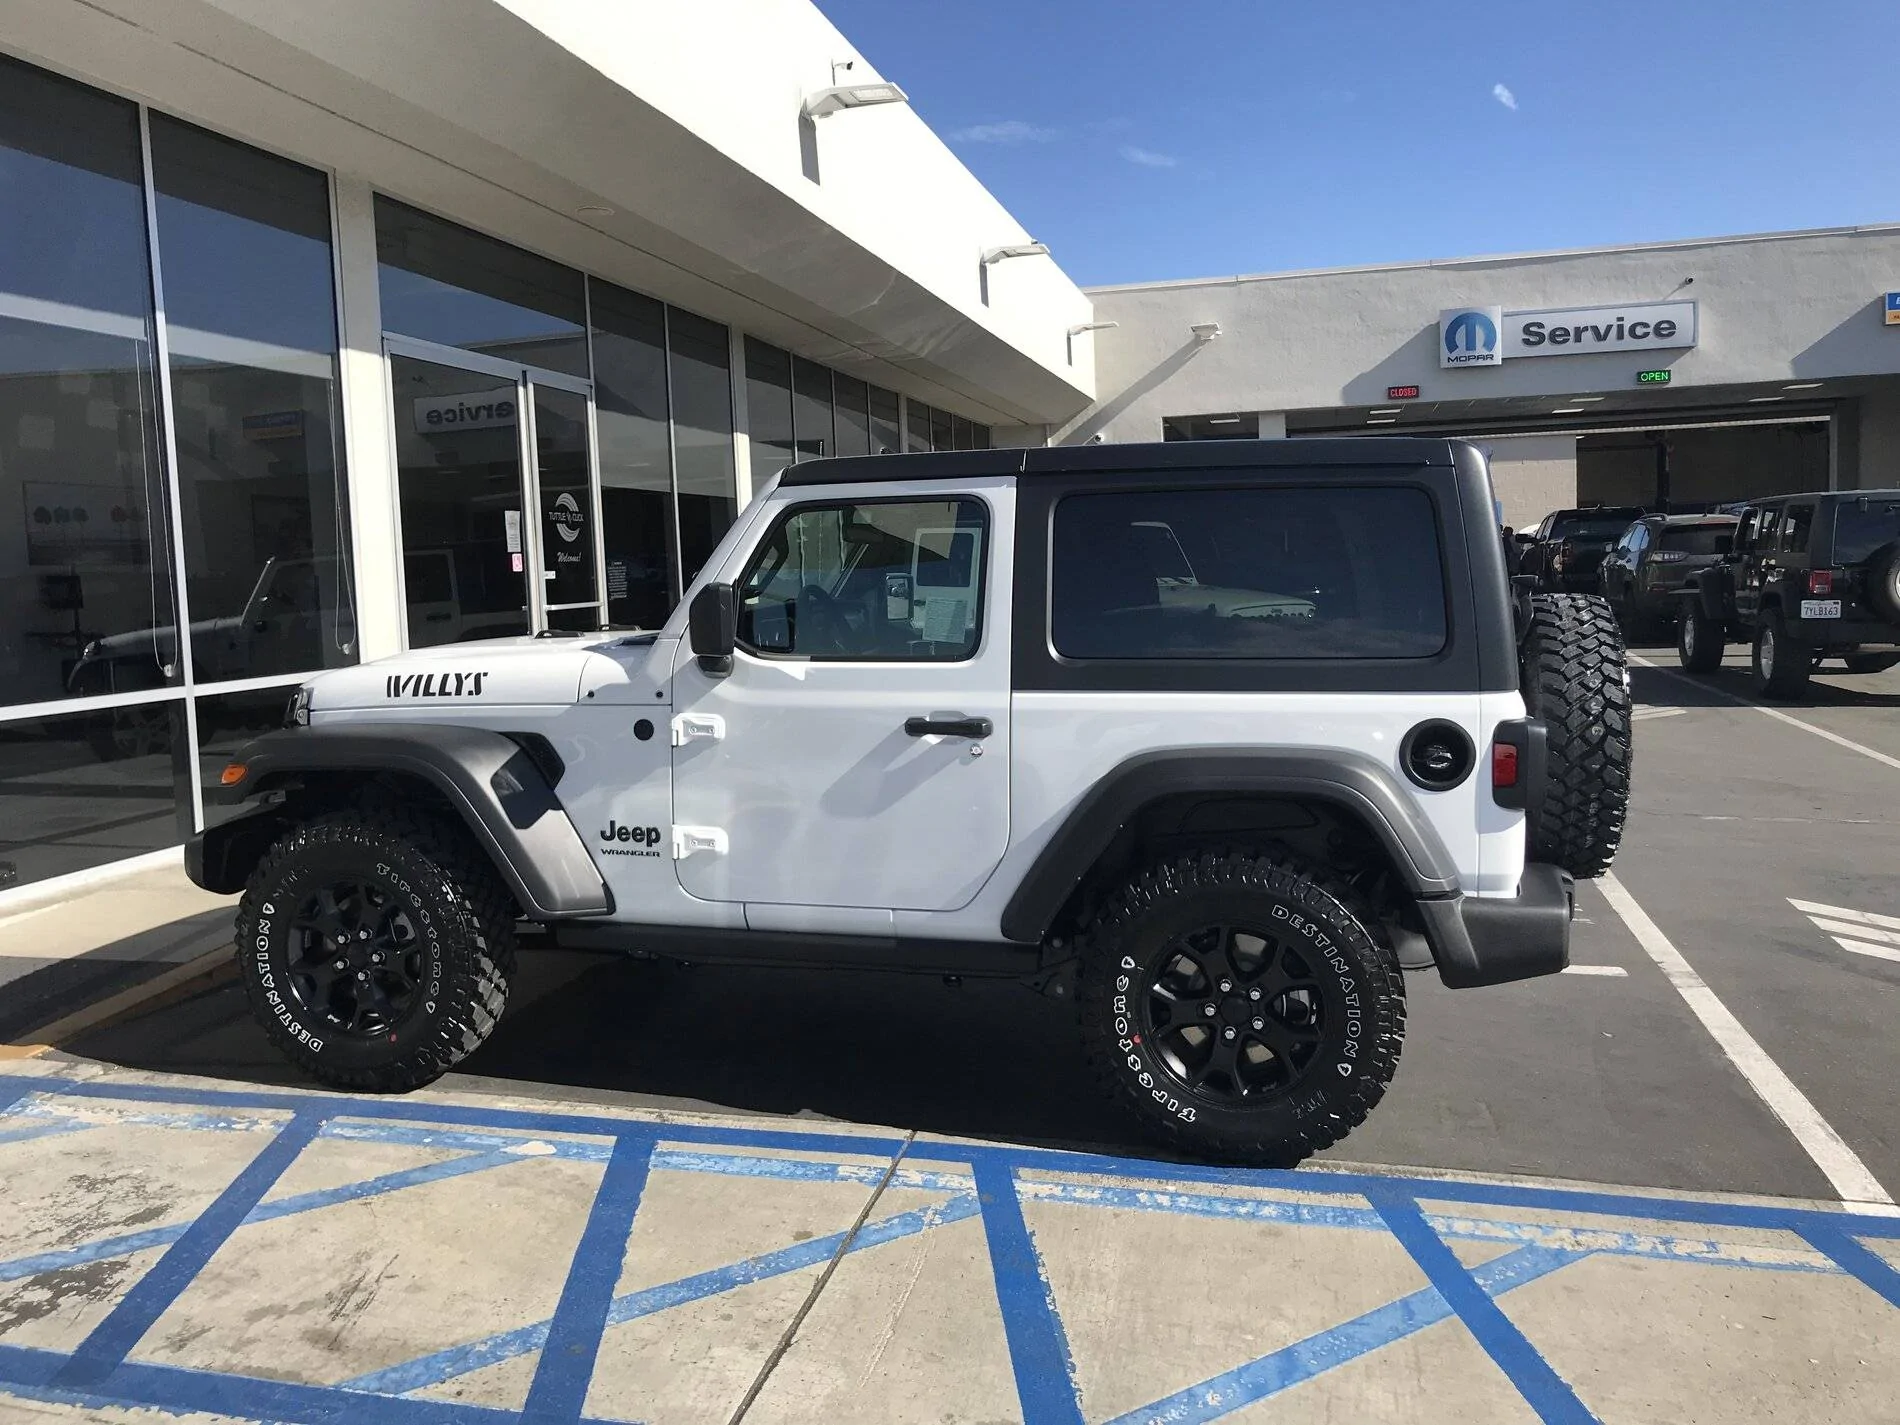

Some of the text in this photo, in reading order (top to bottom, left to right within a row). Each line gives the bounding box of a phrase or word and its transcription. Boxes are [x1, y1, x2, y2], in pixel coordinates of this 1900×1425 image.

[1521, 316, 1677, 347] Service
[1447, 353, 1495, 364] MOPAR
[1640, 371, 1669, 382] OPEN
[1390, 387, 1418, 397] CLOSED
[386, 672, 488, 698] WILLYS
[600, 820, 661, 847] Jeep
[600, 848, 661, 858] WRANGLER
[256, 917, 324, 1052] DESTINATION
[1271, 904, 1361, 1058] DESTINATION
[1113, 974, 1197, 1123] Firestone
